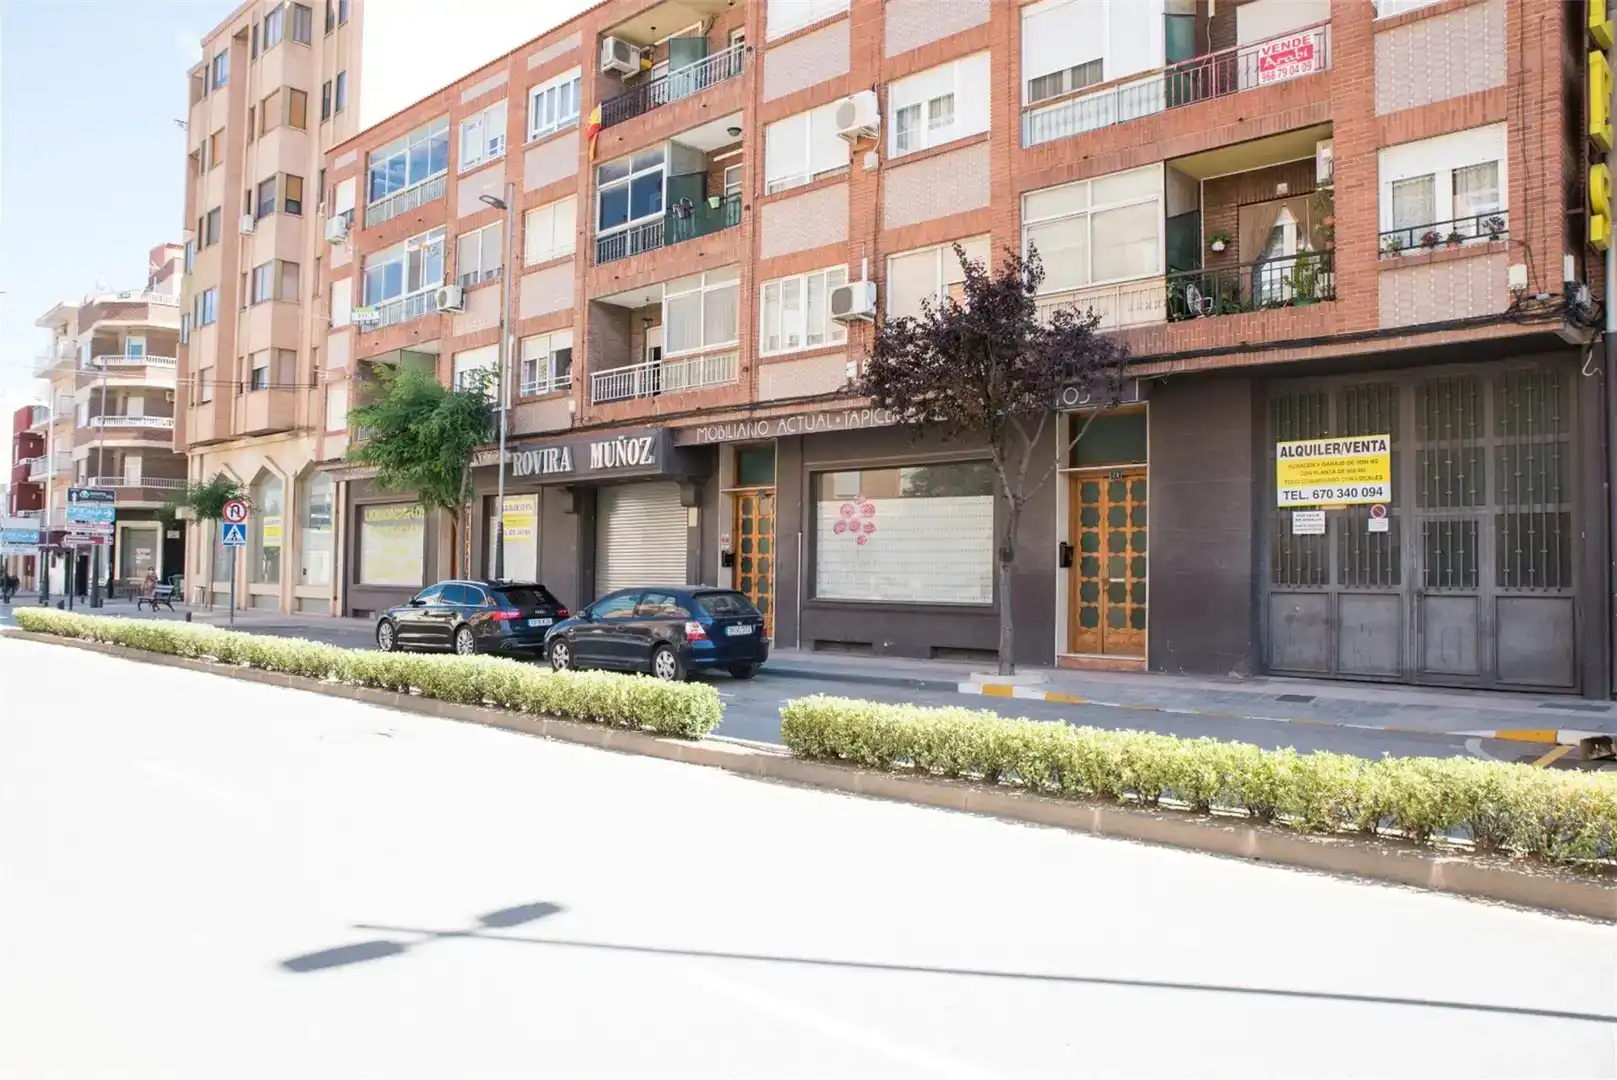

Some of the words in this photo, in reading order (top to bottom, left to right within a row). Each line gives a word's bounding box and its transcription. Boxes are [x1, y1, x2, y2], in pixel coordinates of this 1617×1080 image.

[1261, 36, 1311, 56] VENDE
[696, 420, 770, 443] MOBILIARIO
[778, 413, 833, 435] ACTUAL
[512, 446, 573, 477] ROVIRA
[590, 435, 656, 469] MUÑOZ
[1280, 440, 1388, 458] ALQUILER/VENTA
[1283, 490, 1309, 500] TEL.
[1312, 489, 1333, 499] 670
[1336, 487, 1358, 498] 340
[1361, 486, 1383, 497] 094
